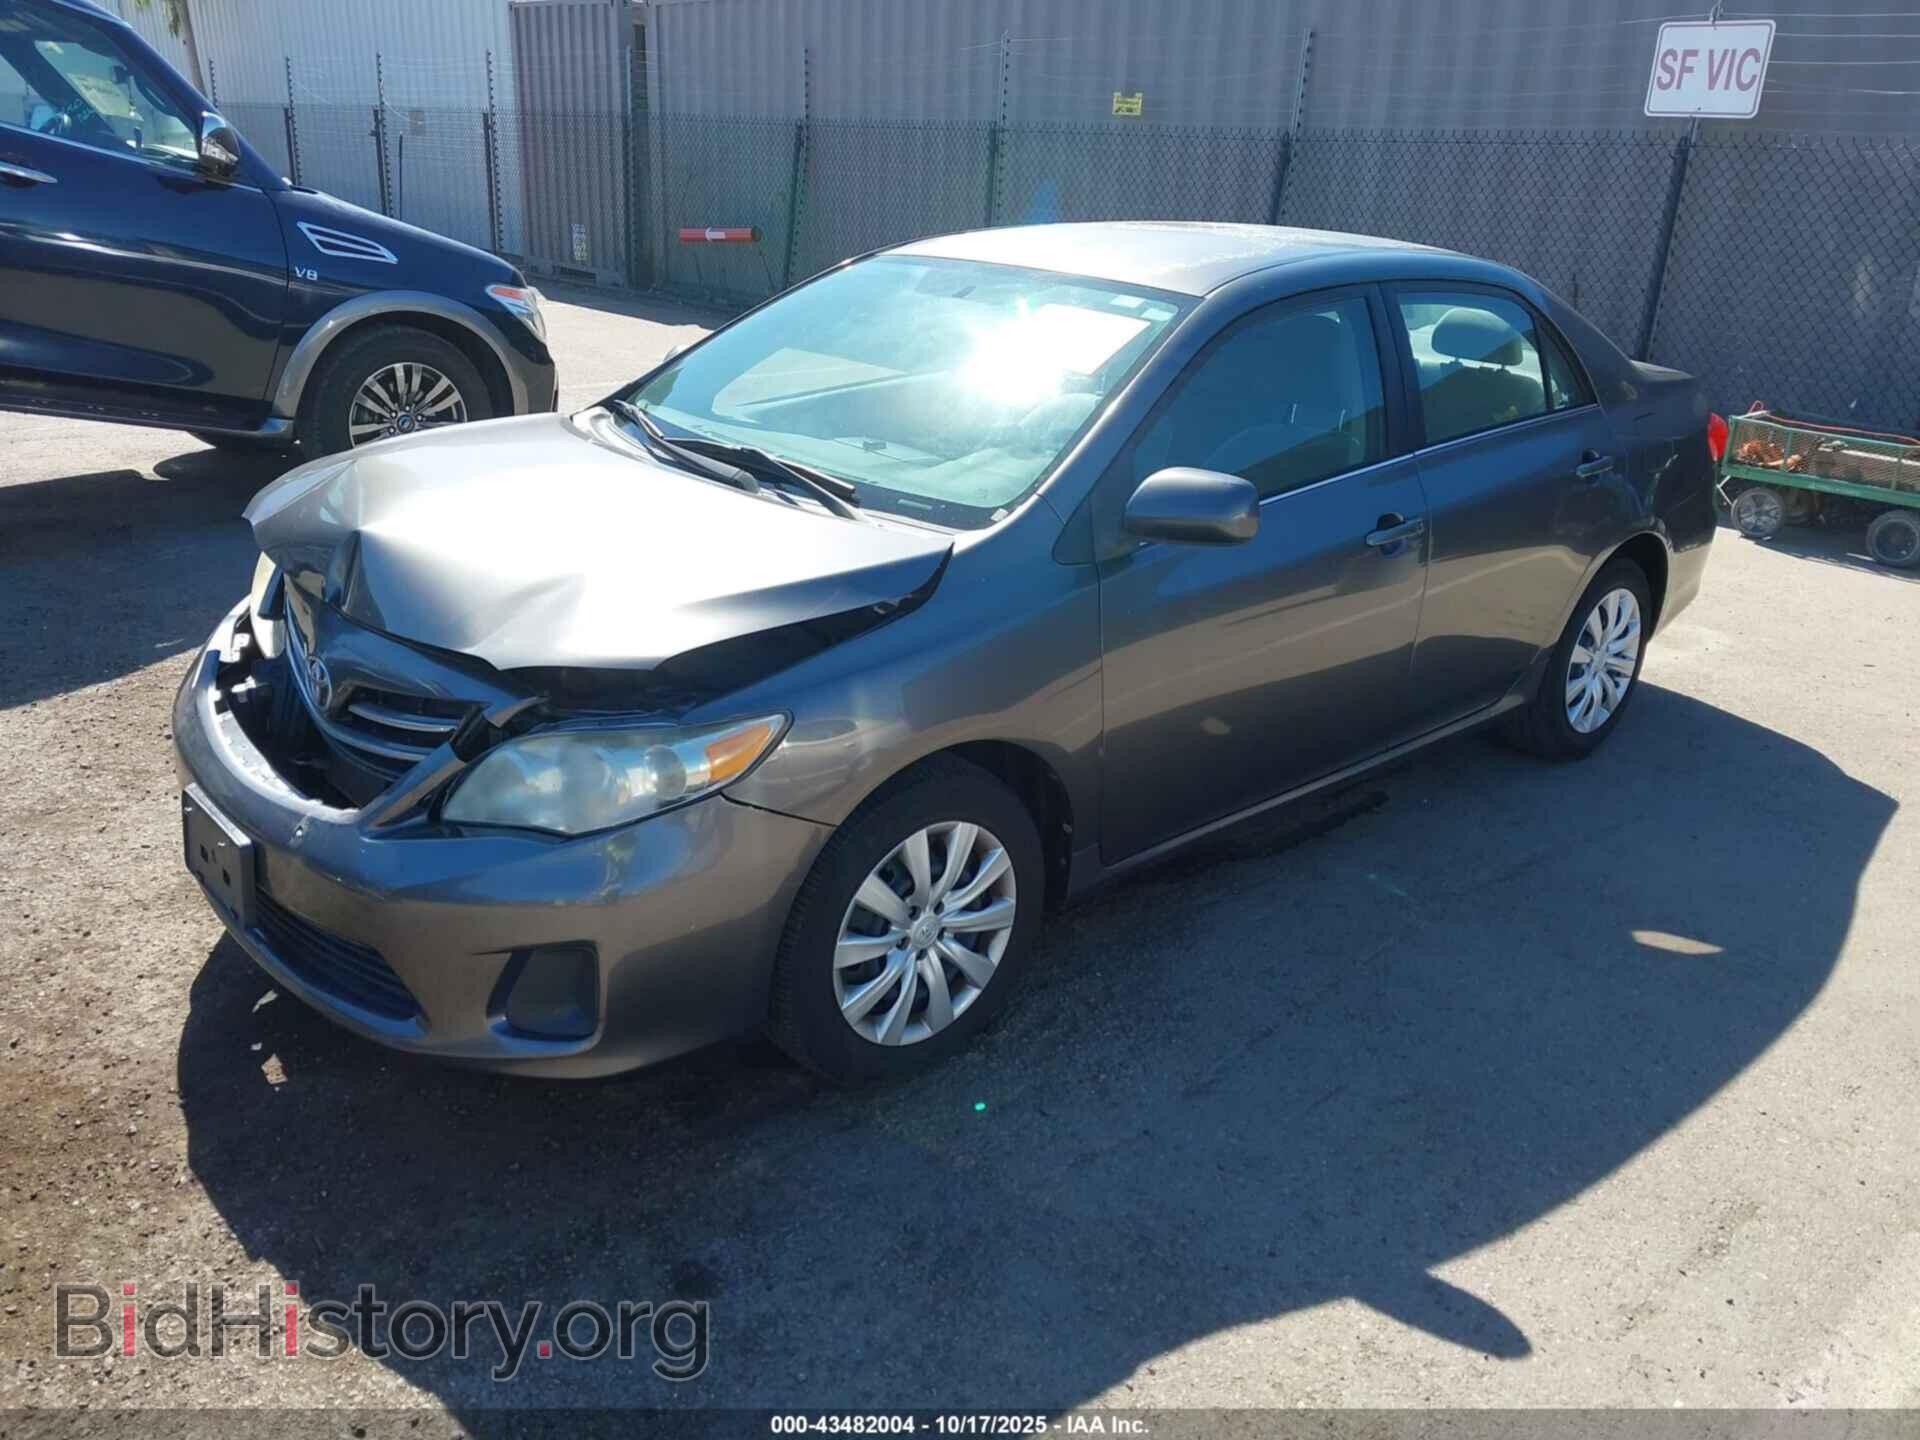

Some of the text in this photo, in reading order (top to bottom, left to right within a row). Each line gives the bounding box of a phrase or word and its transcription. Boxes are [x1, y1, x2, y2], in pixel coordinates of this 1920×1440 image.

[1656, 47, 1761, 91] SF VIC
[294, 265, 318, 281] V8
